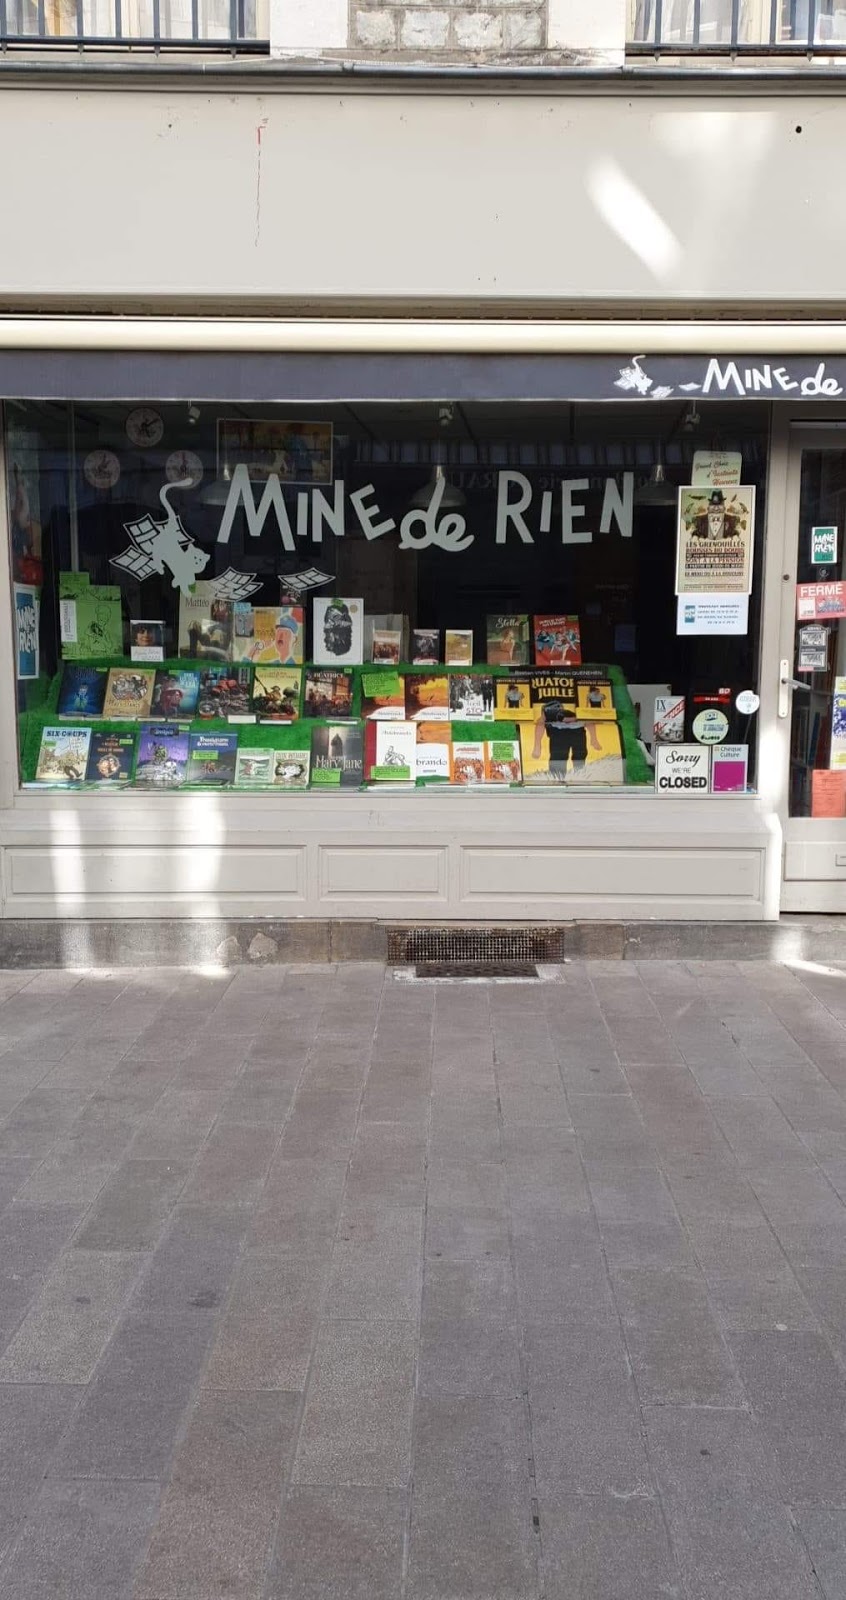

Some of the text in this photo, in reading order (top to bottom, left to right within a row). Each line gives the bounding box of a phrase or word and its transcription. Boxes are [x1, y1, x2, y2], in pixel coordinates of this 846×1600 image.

[702, 358, 844, 396] MINE de
[217, 463, 634, 552] MINE de RIEN
[800, 582, 843, 597] FERMÉ
[316, 755, 363, 771] Mary Jane
[665, 750, 701, 768] Sorry
[659, 777, 707, 788] CLOSED
